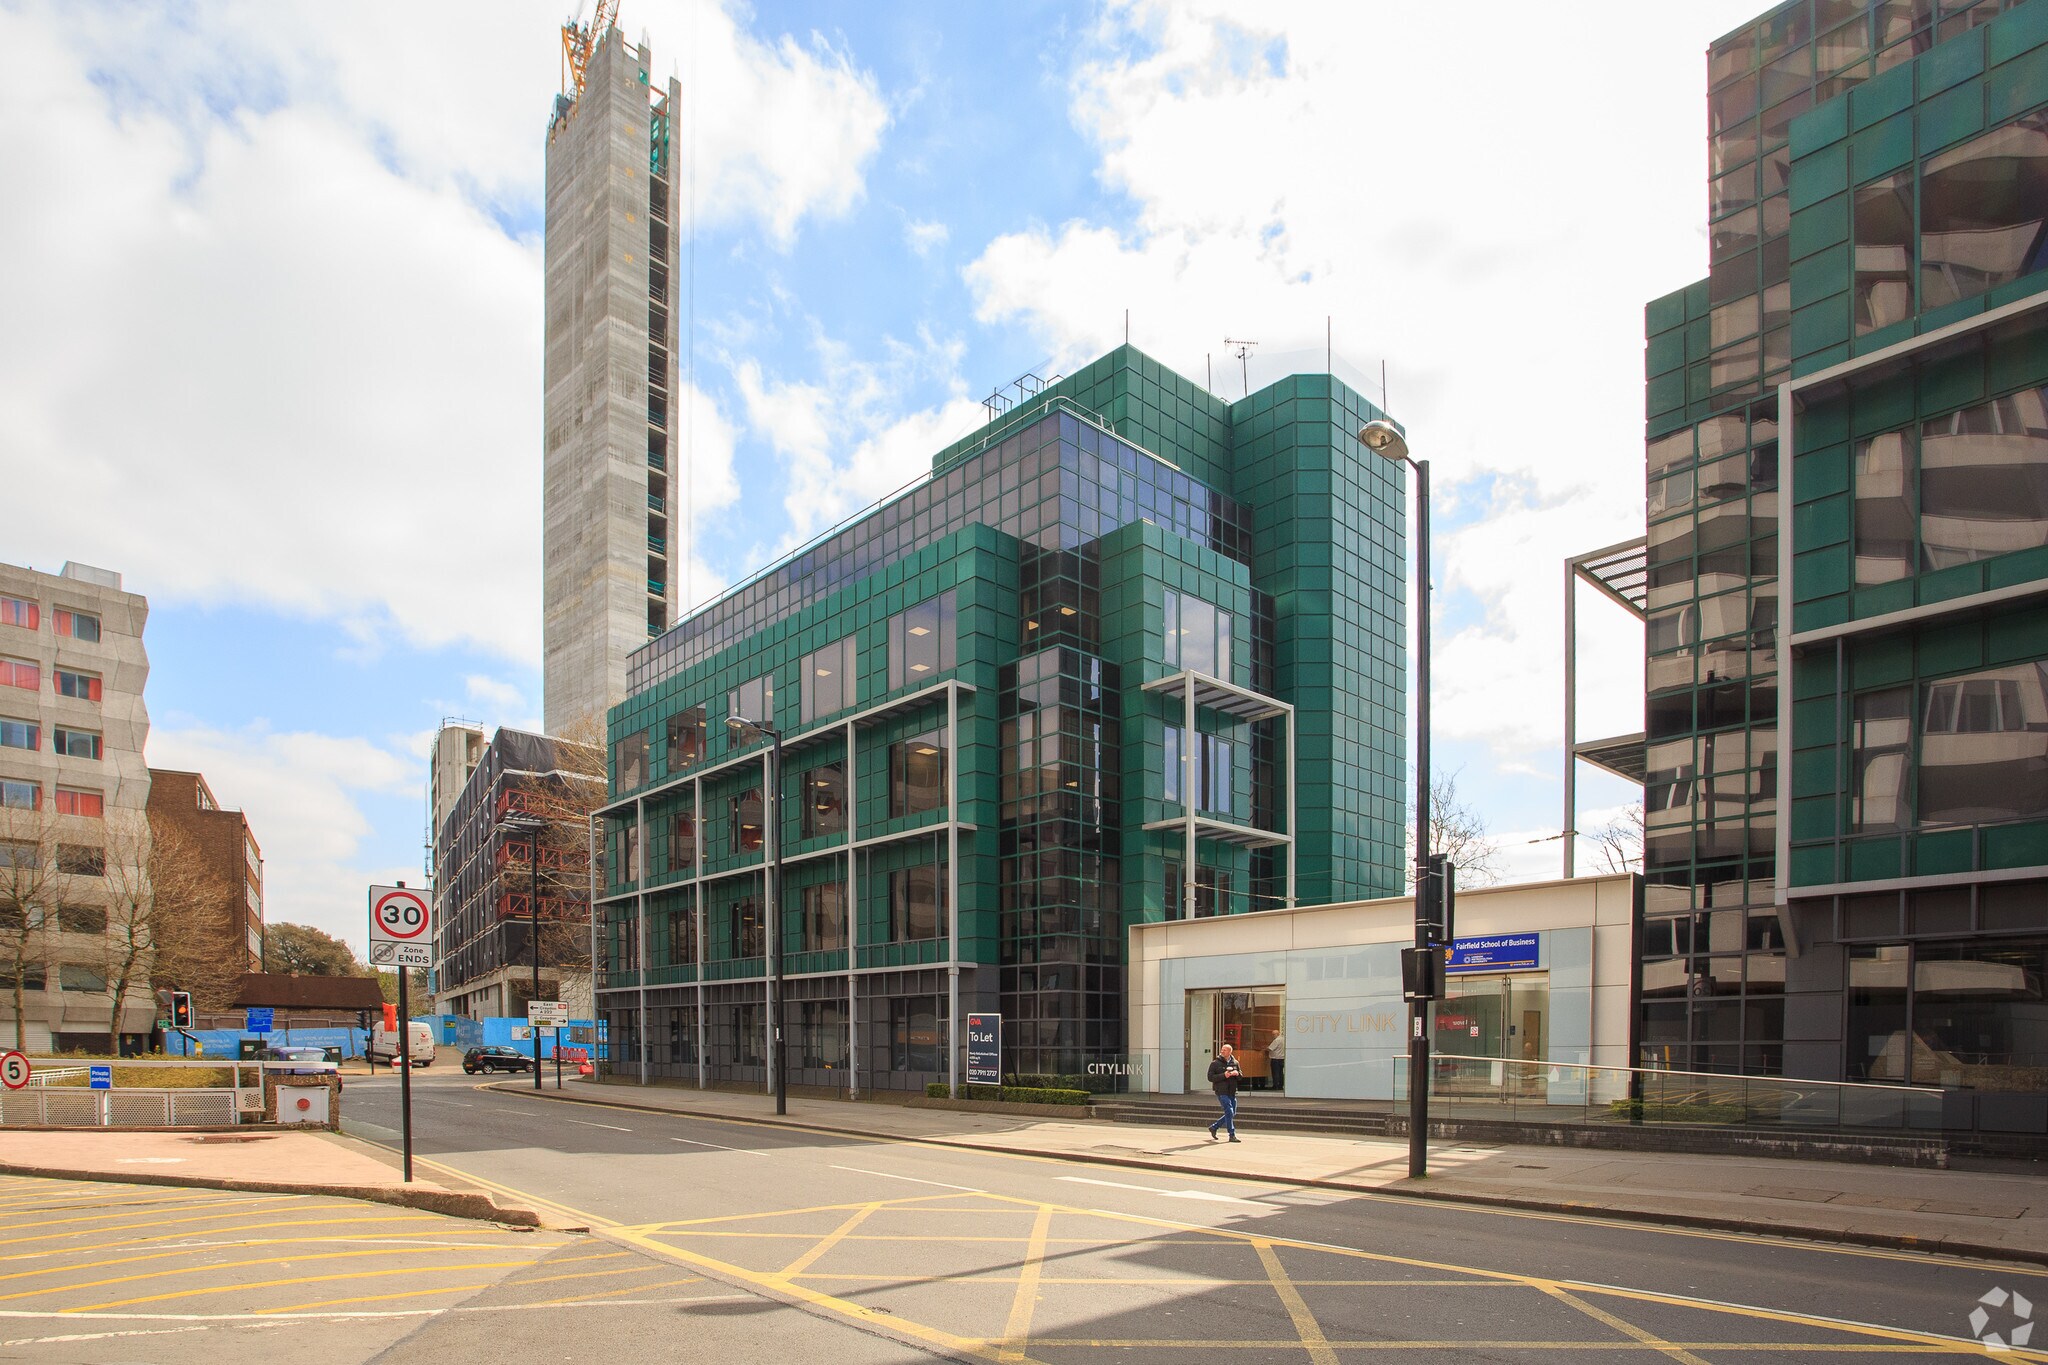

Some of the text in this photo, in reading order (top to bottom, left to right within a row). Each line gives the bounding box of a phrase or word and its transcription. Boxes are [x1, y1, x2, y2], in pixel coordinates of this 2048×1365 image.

[625, 78, 636, 90] 21
[384, 905, 420, 925] 30
[1456, 942, 1480, 950] Fairfield
[1480, 940, 1500, 948] School
[398, 955, 429, 964] ENDS
[1296, 1012, 1396, 1033] CITY LINK
[970, 1032, 993, 1042] To Let
[9, 1062, 20, 1079] 5
[1087, 1063, 1143, 1075] CITYLINK
